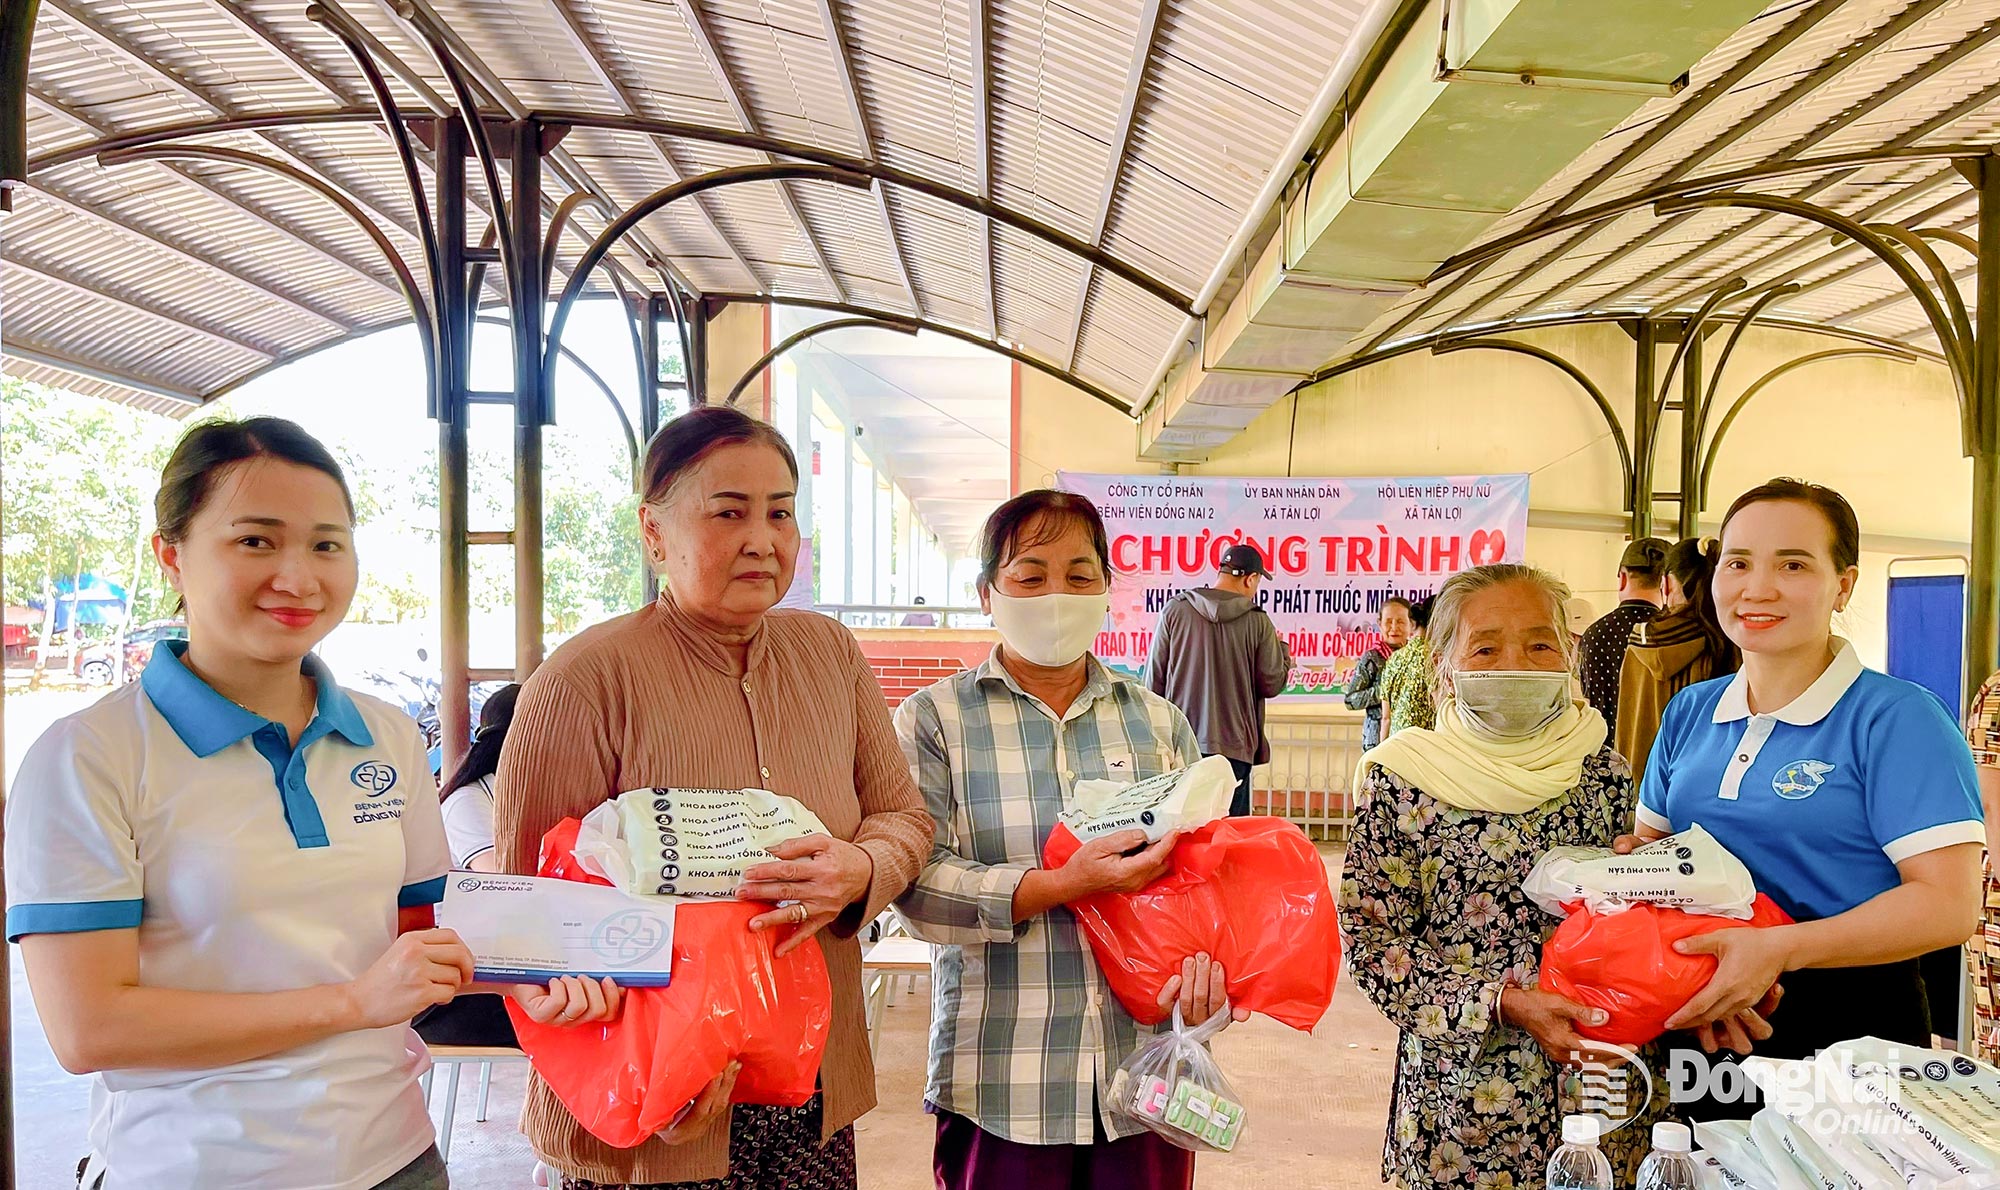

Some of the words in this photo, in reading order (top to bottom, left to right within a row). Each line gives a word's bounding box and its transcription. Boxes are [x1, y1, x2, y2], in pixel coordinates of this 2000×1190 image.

[1108, 482, 1138, 497] CÔNG
[1141, 485, 1154, 497] TY
[1157, 480, 1172, 497] CỔ
[1175, 482, 1204, 497] PHẦN
[1244, 483, 1258, 498] ỦY
[1261, 487, 1283, 498] BAN
[1286, 484, 1315, 498] NHÂN
[1318, 484, 1340, 498] DÂN
[1378, 484, 1396, 501] HỘI
[1399, 484, 1422, 498] LIÊN
[1425, 483, 1449, 501] HIỆP
[1452, 486, 1473, 501] PHỤ
[1476, 483, 1491, 498] NỮ
[1128, 504, 1152, 521] VIỆN
[1155, 502, 1185, 519] ĐỒNG
[1188, 507, 1206, 519] NAI
[1208, 507, 1215, 519] 2
[1264, 504, 1277, 519] XÃ
[1280, 504, 1300, 519] TÂN
[1304, 506, 1321, 522] LỢI
[1405, 504, 1418, 519] XÃ
[1422, 504, 1442, 519] TÂN
[1445, 506, 1462, 521] LỢI
[1111, 528, 1308, 573] CHƯƠNG
[1319, 525, 1461, 573] TRÌNH
[1146, 583, 1186, 613] KHÁ
[1274, 584, 1311, 613] PHÁT
[1315, 580, 1361, 613] THUỐC
[1289, 627, 1318, 657] DÂN
[1323, 626, 1341, 657] CÓ
[1301, 669, 1337, 687] ngày
[1115, 818, 1135, 828] KHOA
[686, 842, 714, 850] KHOA
[688, 870, 715, 878] KHOA
[1608, 867, 1625, 875] SẢN
[1648, 888, 1675, 896] BỆNH
